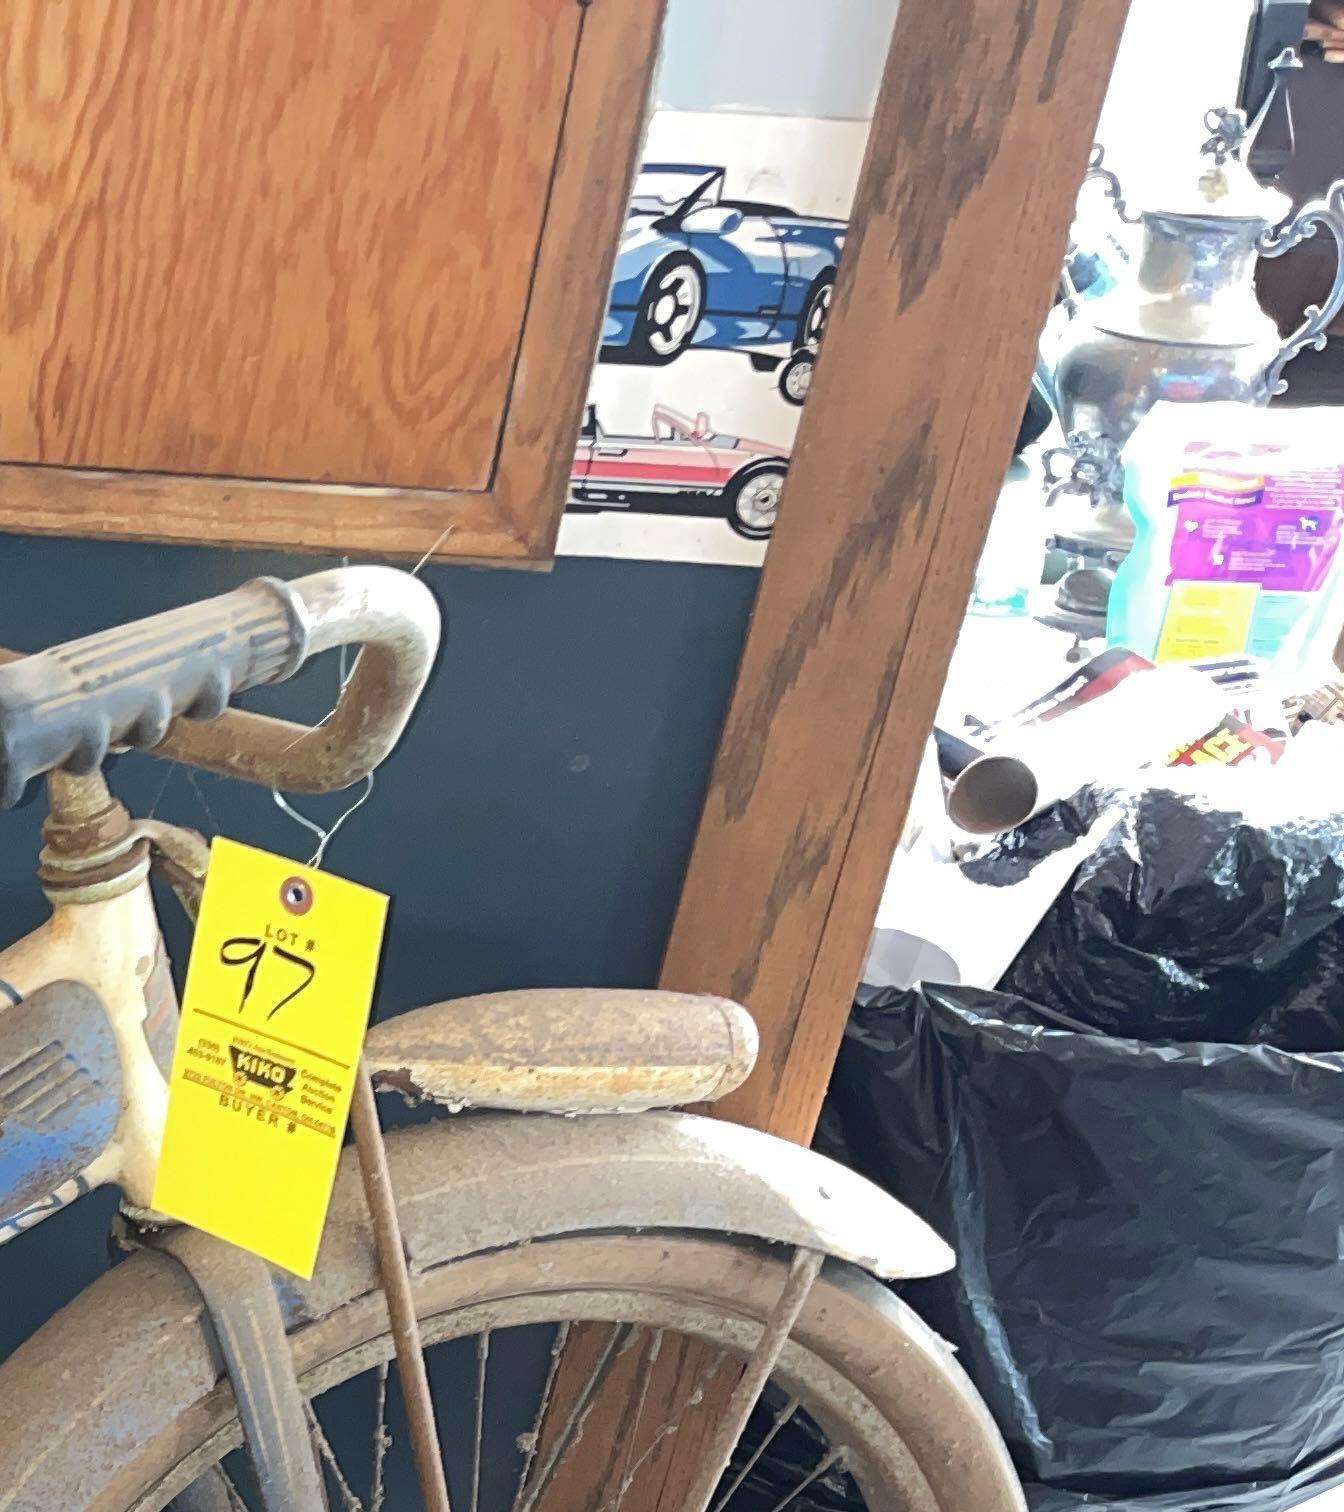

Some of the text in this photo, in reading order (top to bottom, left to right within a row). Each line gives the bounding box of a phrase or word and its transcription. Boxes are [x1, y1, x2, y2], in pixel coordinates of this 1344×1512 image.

[264, 923, 299, 946] LOT
[219, 936, 316, 1021] 97
[236, 1052, 287, 1084] KIKO
[218, 1093, 280, 1128] BUYER
